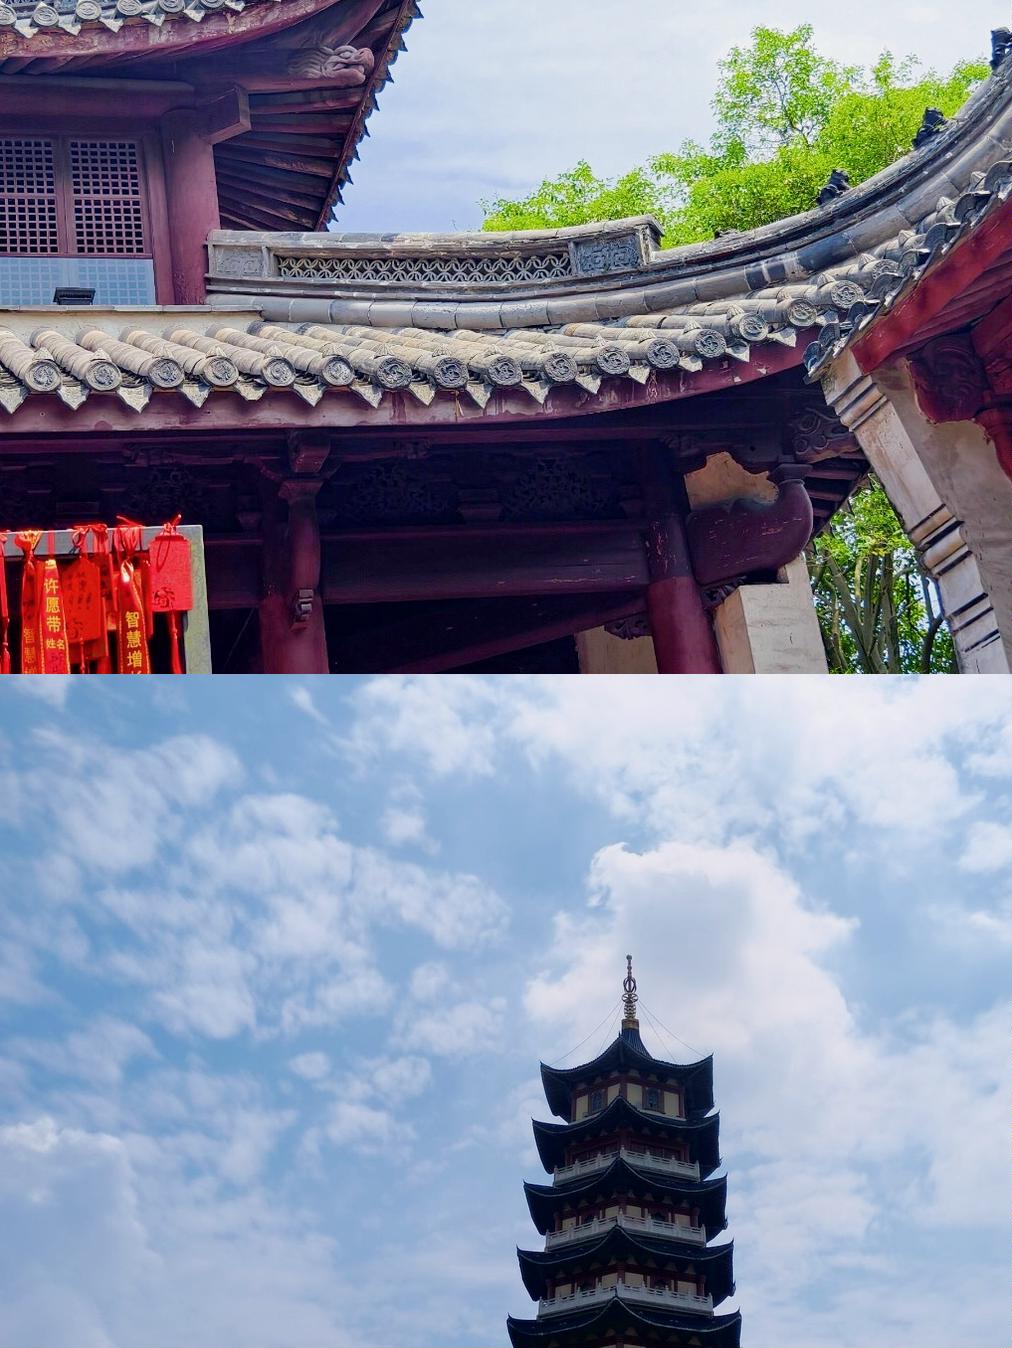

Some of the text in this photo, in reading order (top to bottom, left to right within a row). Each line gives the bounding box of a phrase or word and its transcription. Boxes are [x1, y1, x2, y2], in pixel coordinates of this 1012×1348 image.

[46, 638, 65, 650] 姓名
[126, 612, 143, 674] 智慧增
